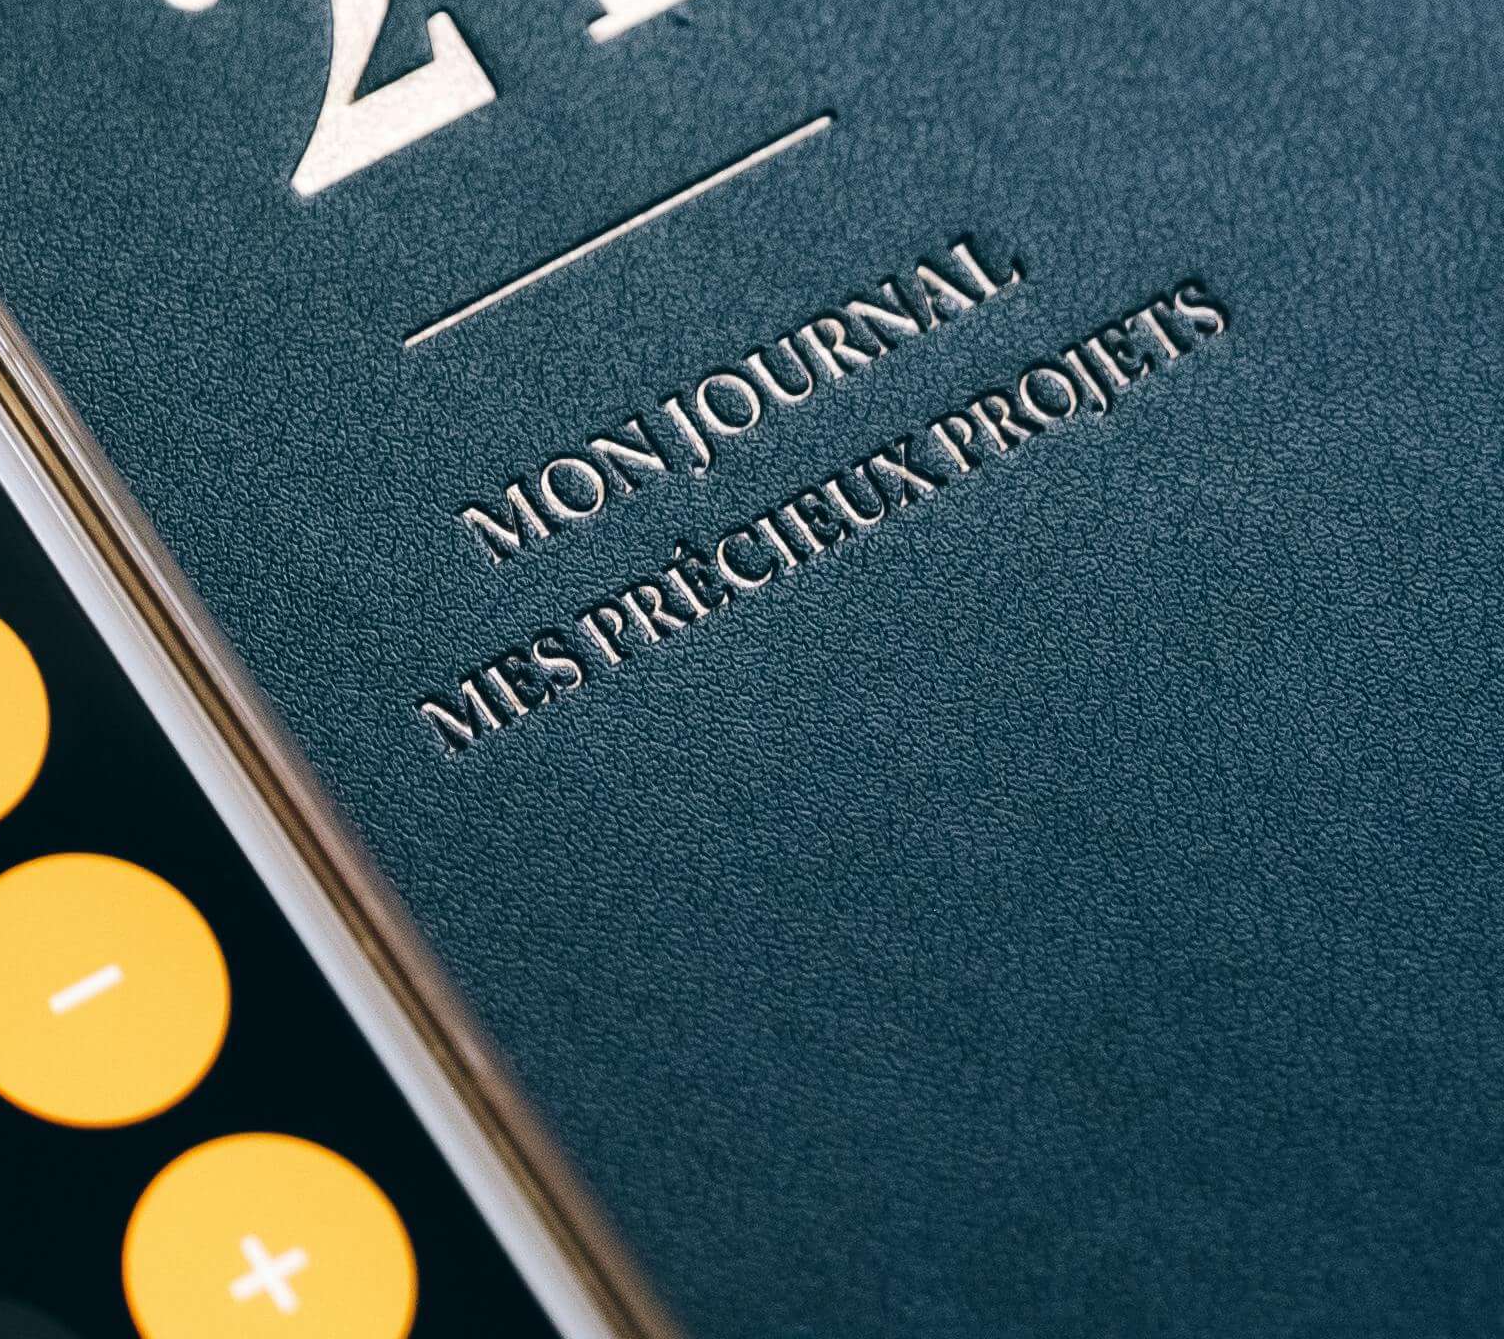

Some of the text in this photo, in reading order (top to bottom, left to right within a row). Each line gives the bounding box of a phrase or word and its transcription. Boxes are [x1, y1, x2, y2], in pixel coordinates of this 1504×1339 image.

[418, 278, 1228, 755] MES PRÉCIEUX PROJETS
[458, 234, 1023, 566] MON JOURNAL
